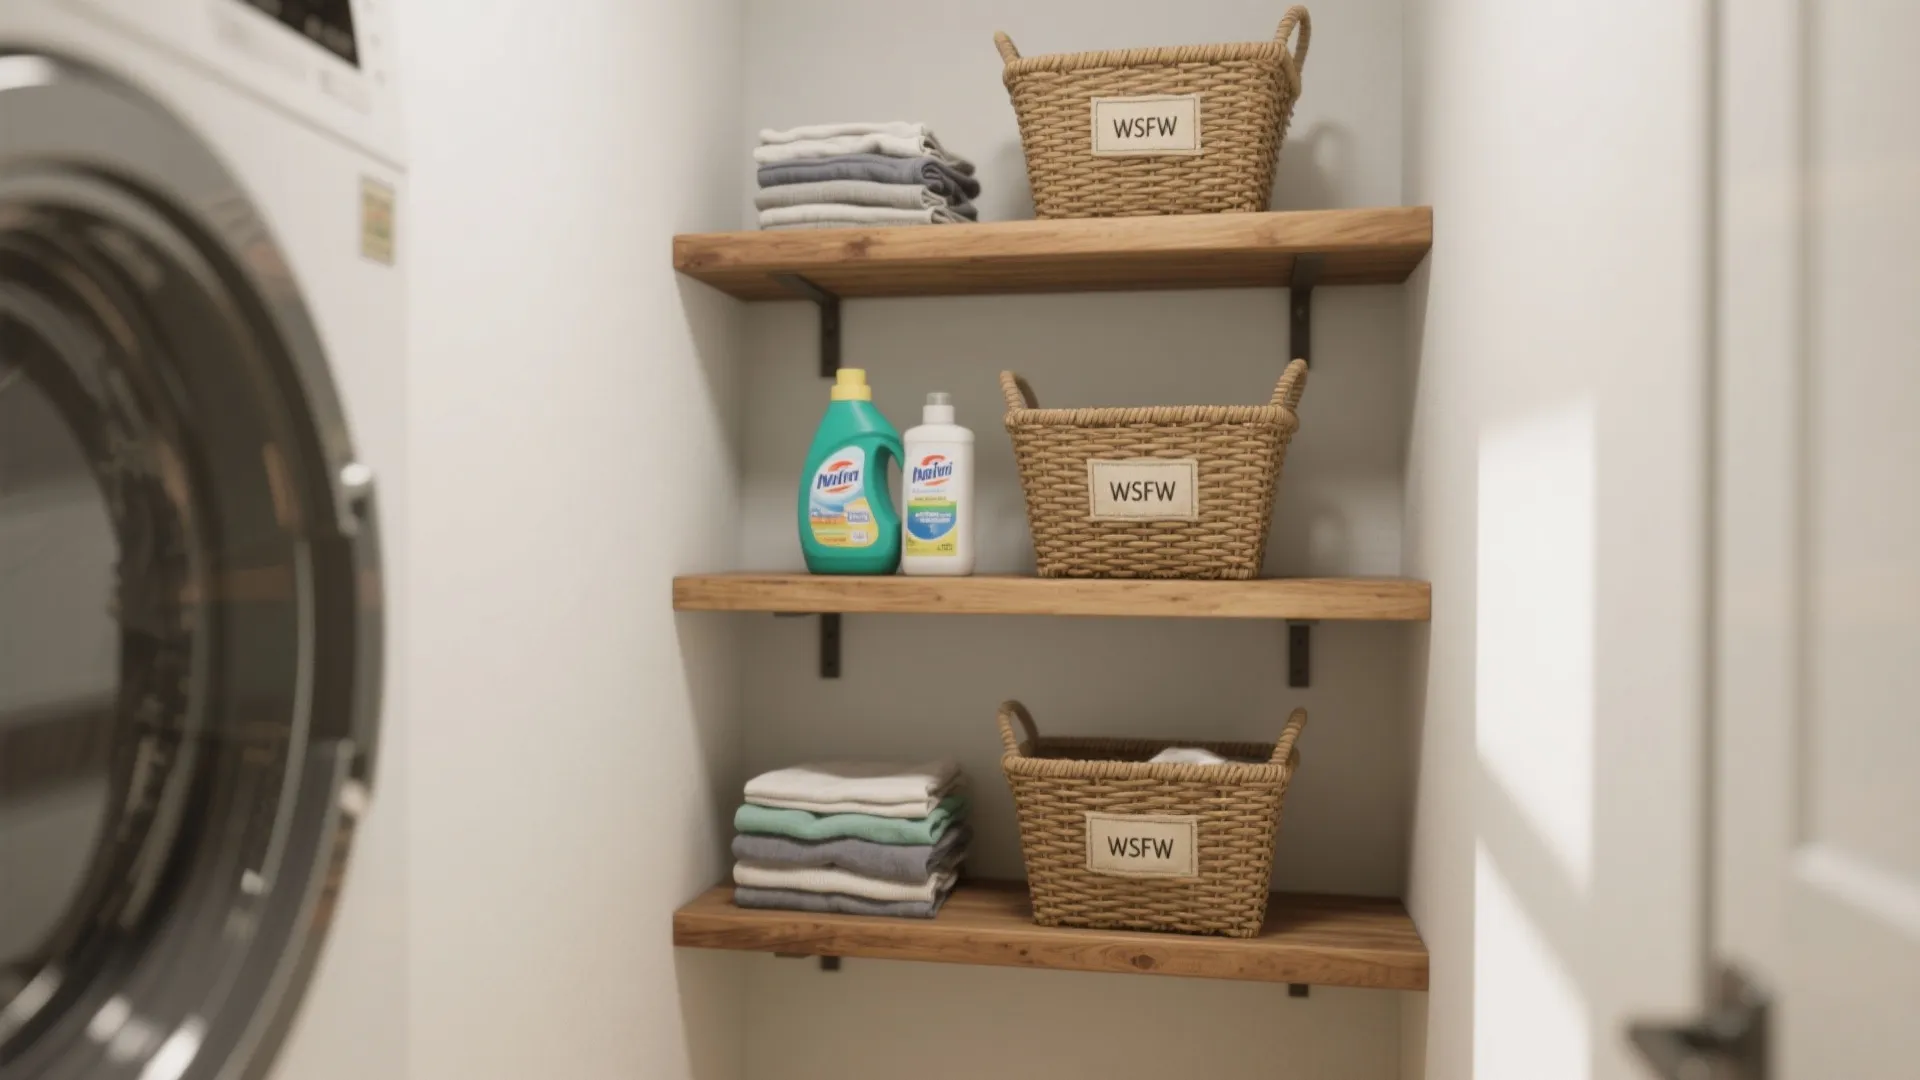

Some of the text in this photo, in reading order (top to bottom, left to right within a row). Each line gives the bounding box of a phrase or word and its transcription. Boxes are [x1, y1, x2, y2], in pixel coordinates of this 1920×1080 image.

[1113, 116, 1177, 139] WSFW
[1110, 481, 1176, 502] WSFW
[1107, 836, 1174, 859] WSFW
